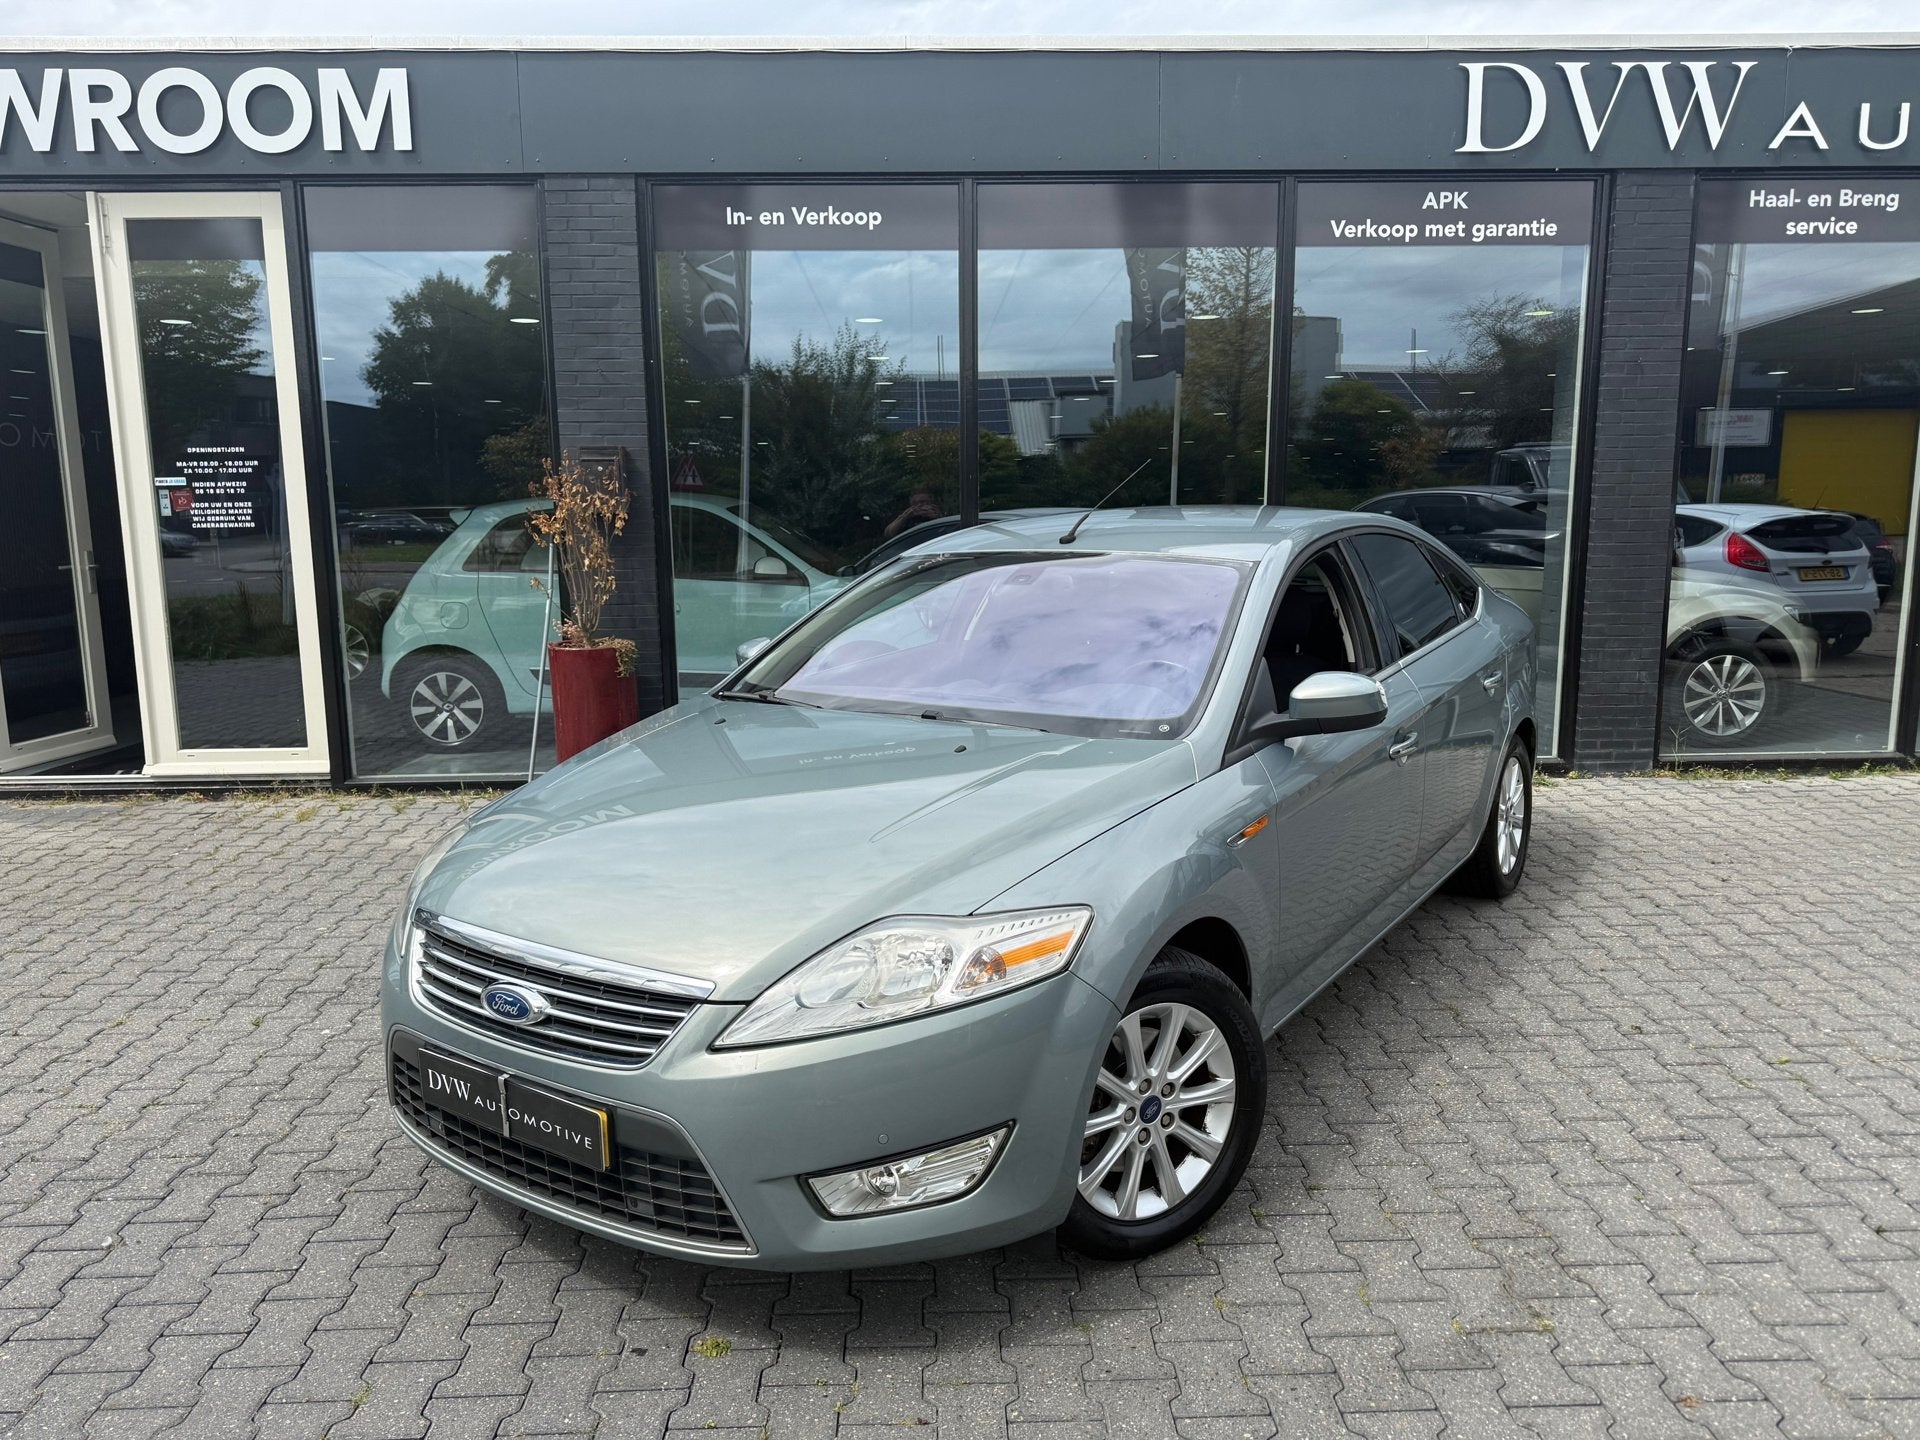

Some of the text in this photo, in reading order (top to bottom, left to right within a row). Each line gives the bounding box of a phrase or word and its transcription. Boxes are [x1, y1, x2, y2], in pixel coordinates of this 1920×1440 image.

[1454, 61, 1911, 153] DVW AU
[1421, 191, 1469, 210] APK
[1749, 188, 1900, 212] Haal- en Breng
[726, 205, 882, 231] In- en Verkoop
[1786, 216, 1858, 235] service
[1330, 218, 1558, 243] Verkoop met garantie
[492, 993, 521, 1016] Ford
[427, 1068, 593, 1150] DVW AUOMOTIVE
